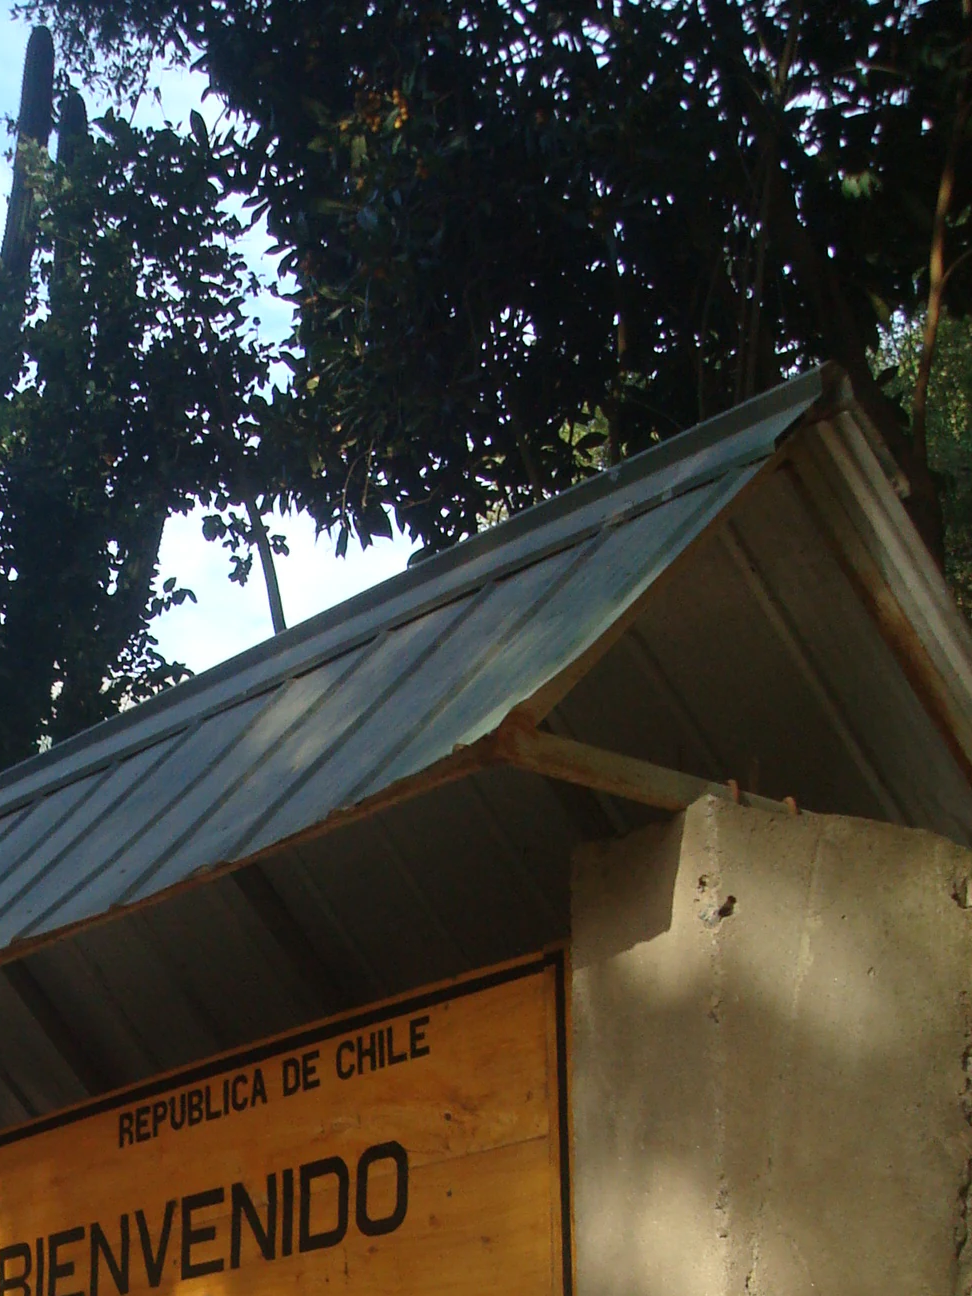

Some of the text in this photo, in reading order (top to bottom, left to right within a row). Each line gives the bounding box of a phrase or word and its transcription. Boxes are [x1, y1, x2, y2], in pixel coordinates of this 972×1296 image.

[118, 1016, 430, 1148] REPUBLICA DE CHILE
